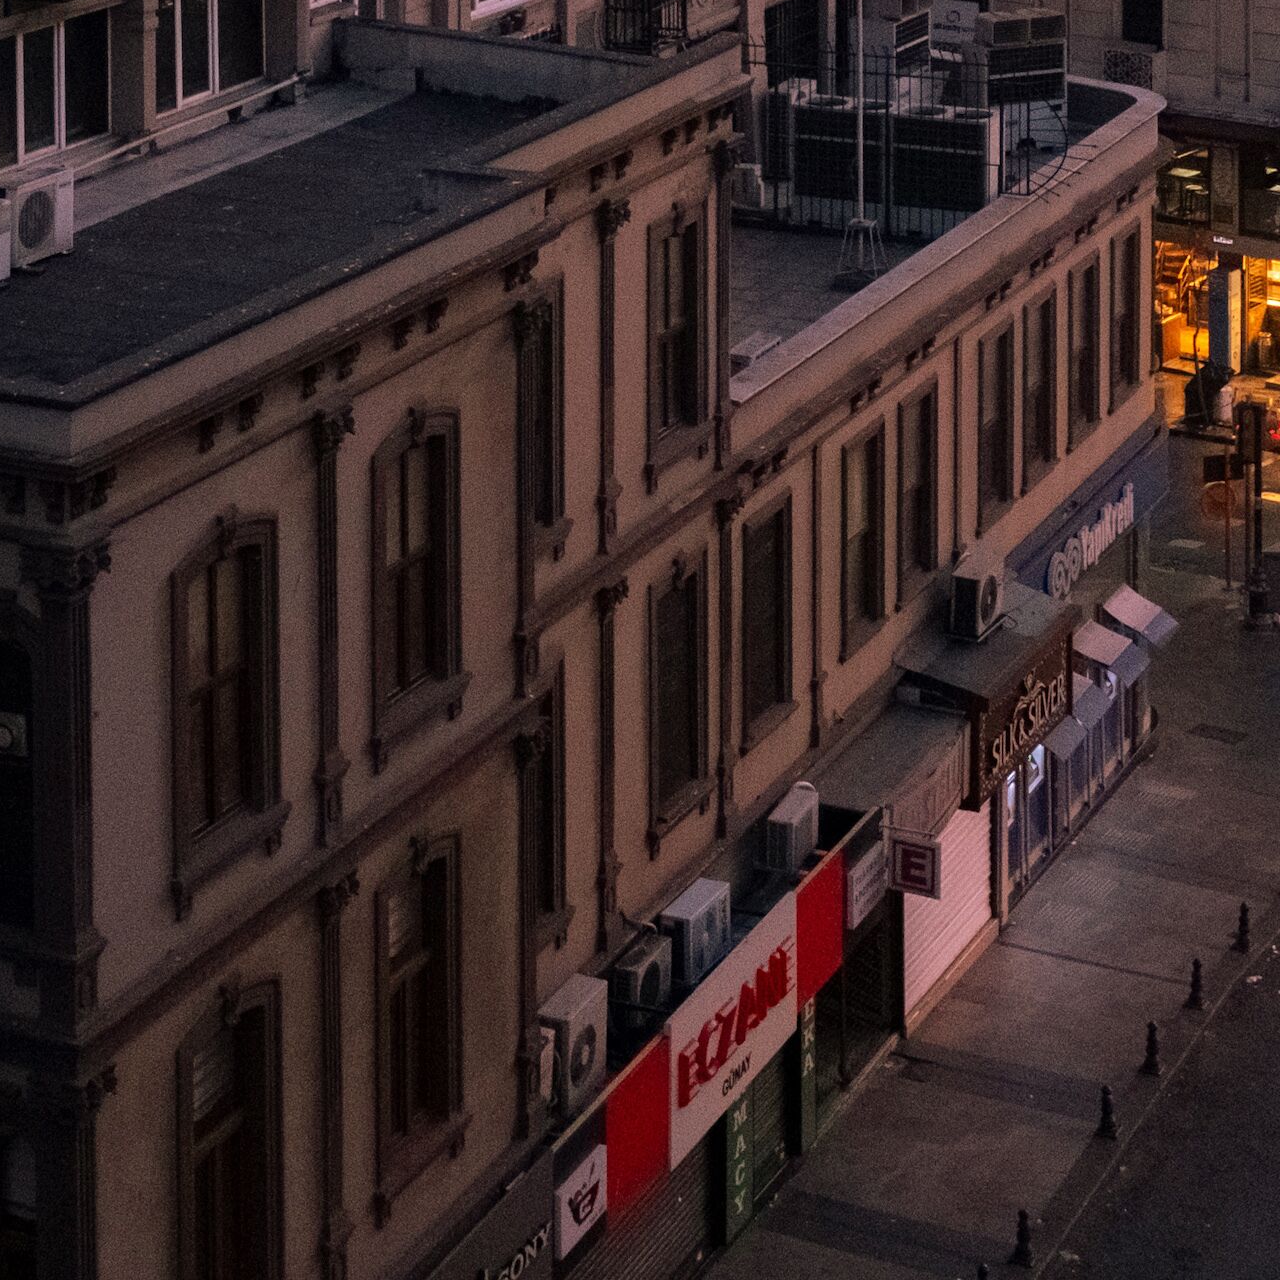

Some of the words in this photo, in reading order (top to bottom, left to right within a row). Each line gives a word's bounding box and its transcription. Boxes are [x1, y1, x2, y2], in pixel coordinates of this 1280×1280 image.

[992, 718, 1019, 774] SILK
[1028, 674, 1066, 735] SILVER
[901, 847, 927, 886] E
[677, 936, 795, 1109] ECZANE
[721, 1053, 752, 1096] GÜNAY
